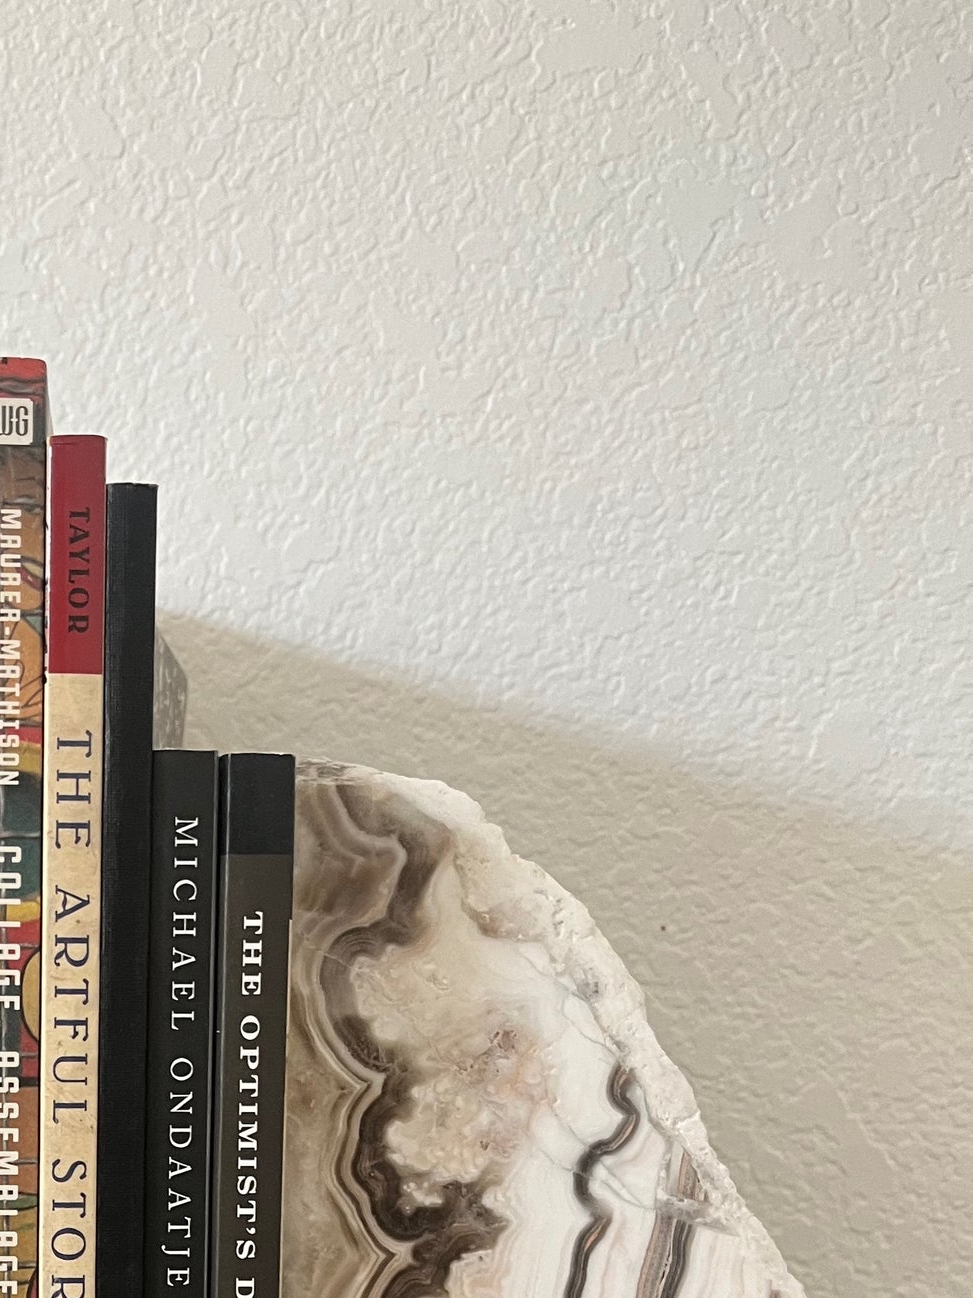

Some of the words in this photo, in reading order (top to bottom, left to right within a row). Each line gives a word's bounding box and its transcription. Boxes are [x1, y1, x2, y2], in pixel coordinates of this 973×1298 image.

[67, 507, 91, 635] TAYLOR
[55, 730, 93, 849] THE
[52, 885, 91, 1124] ARTFUL
[170, 816, 199, 1030] MICHAEL
[240, 911, 265, 996] THE
[160, 1056, 195, 1287] ONDAATJE
[234, 1015, 262, 1260] OPTIMIST'S
